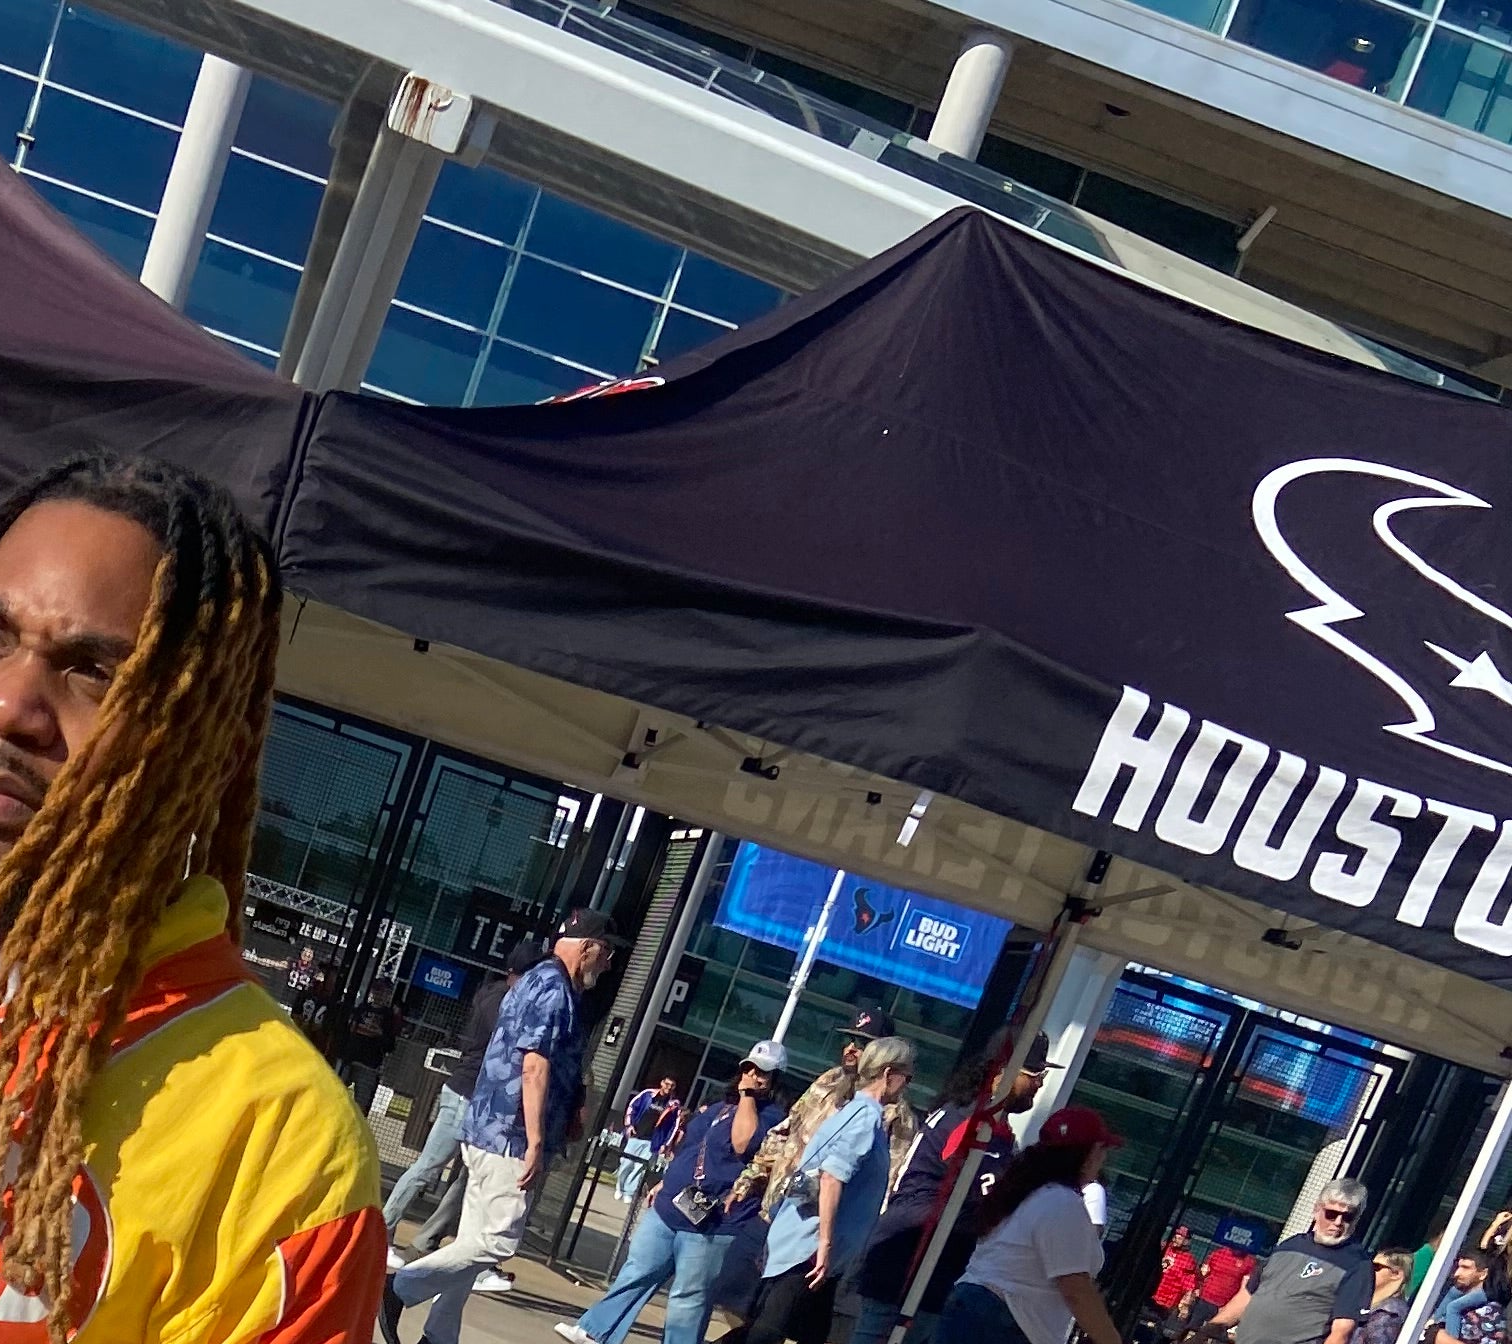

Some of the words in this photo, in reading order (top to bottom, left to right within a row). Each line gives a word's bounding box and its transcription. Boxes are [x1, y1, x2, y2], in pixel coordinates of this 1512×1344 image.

[919, 916, 958, 940] BUD
[905, 929, 960, 958] LIGHT
[424, 973, 454, 989] LIGHT
[430, 966, 452, 980] BUD
[1223, 1231, 1254, 1247] LIGHT
[1231, 1226, 1253, 1238] BUD
